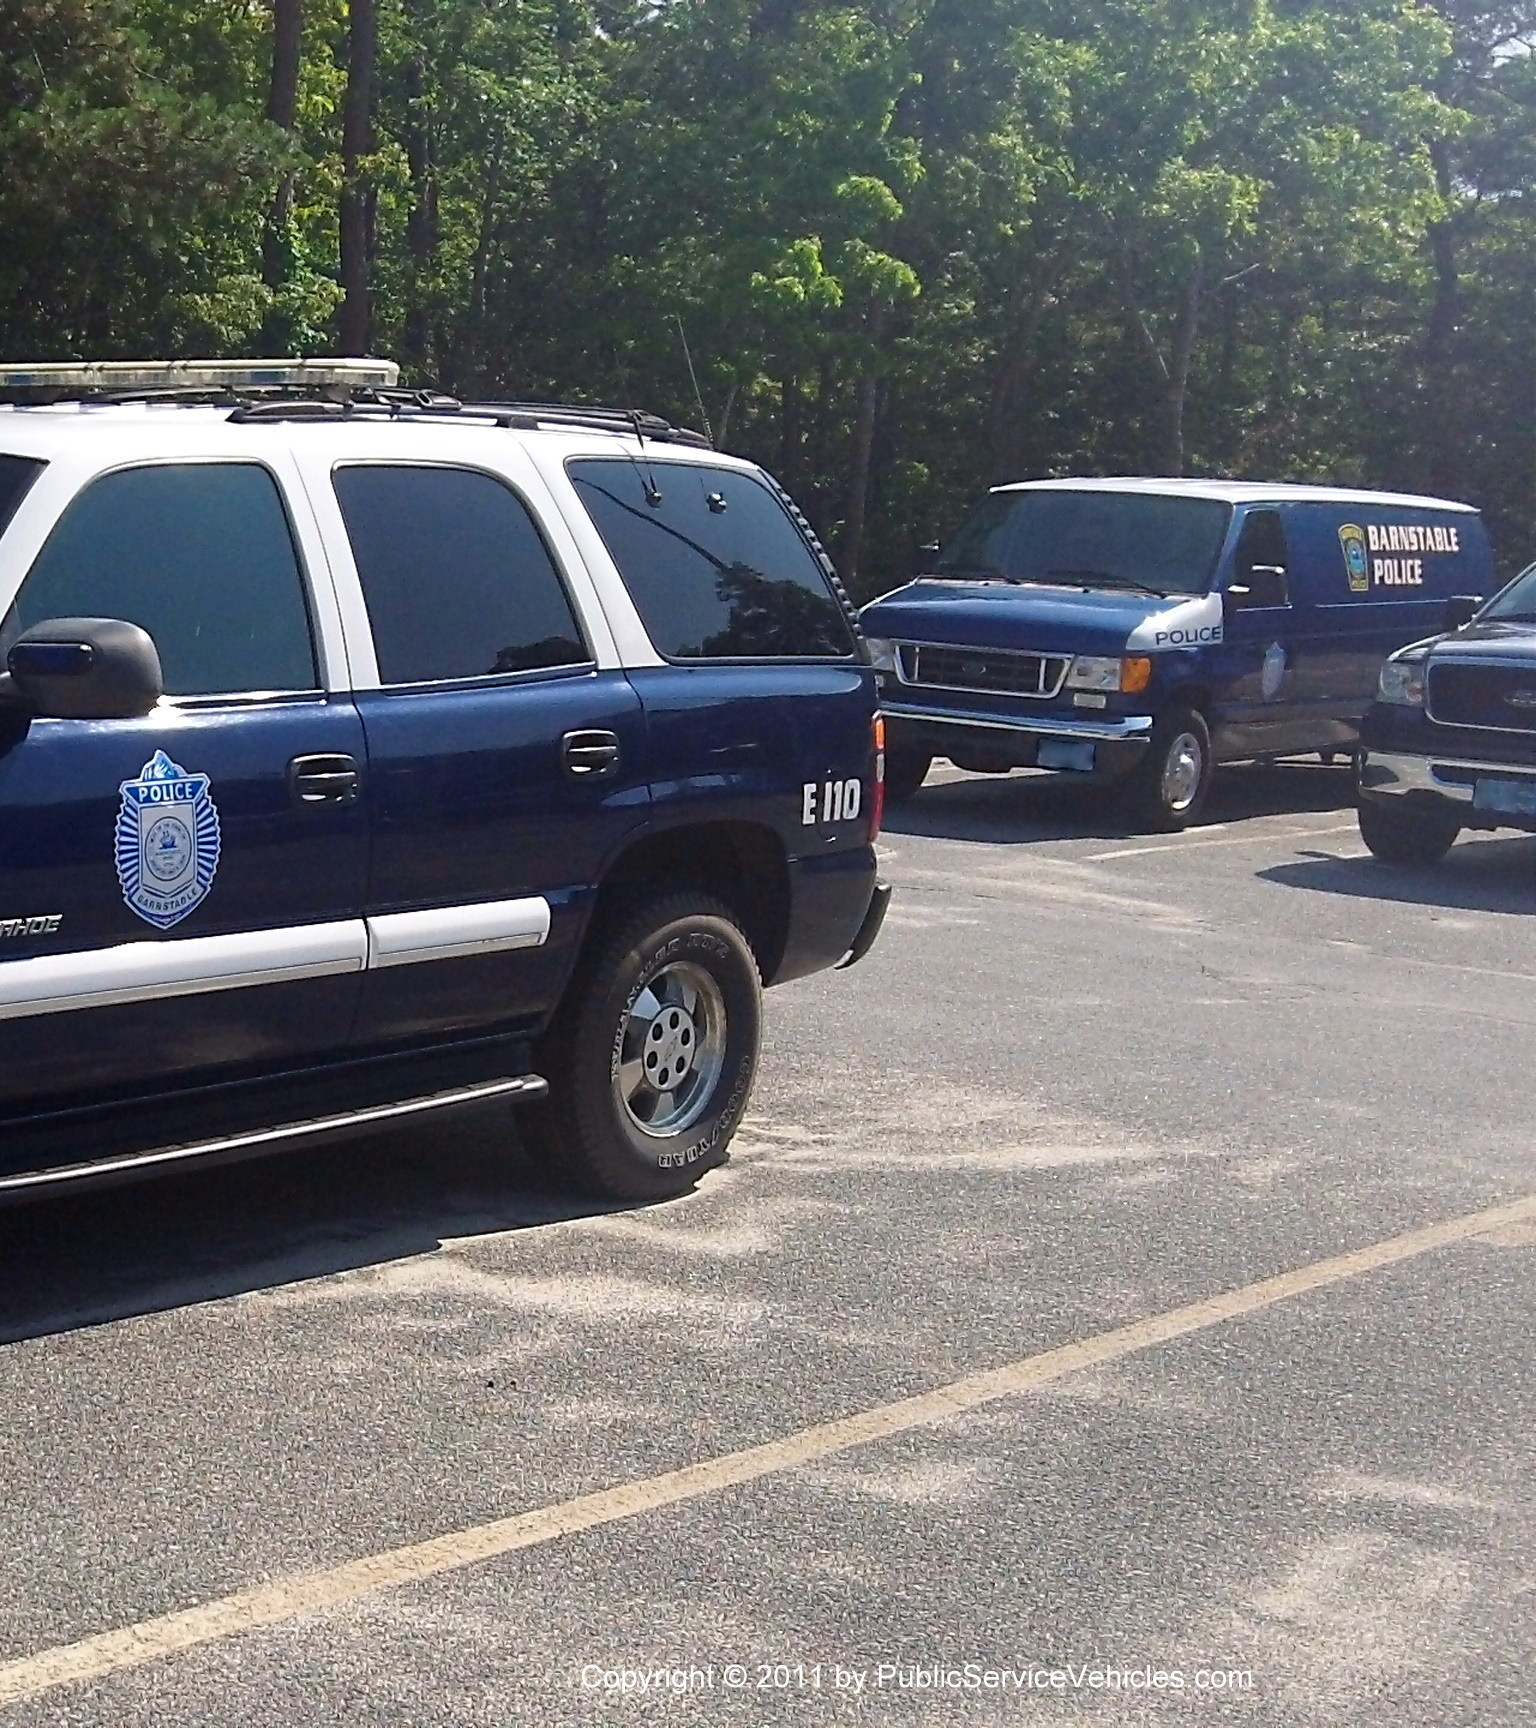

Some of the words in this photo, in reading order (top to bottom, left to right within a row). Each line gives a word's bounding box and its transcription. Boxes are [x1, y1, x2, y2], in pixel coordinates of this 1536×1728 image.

[1367, 525, 1460, 552] BARNSTABLE
[1373, 558, 1423, 585] POLICE
[1155, 626, 1221, 645] POLICE
[138, 783, 193, 802] POLICE
[802, 783, 817, 825] E
[823, 778, 861, 822] 110
